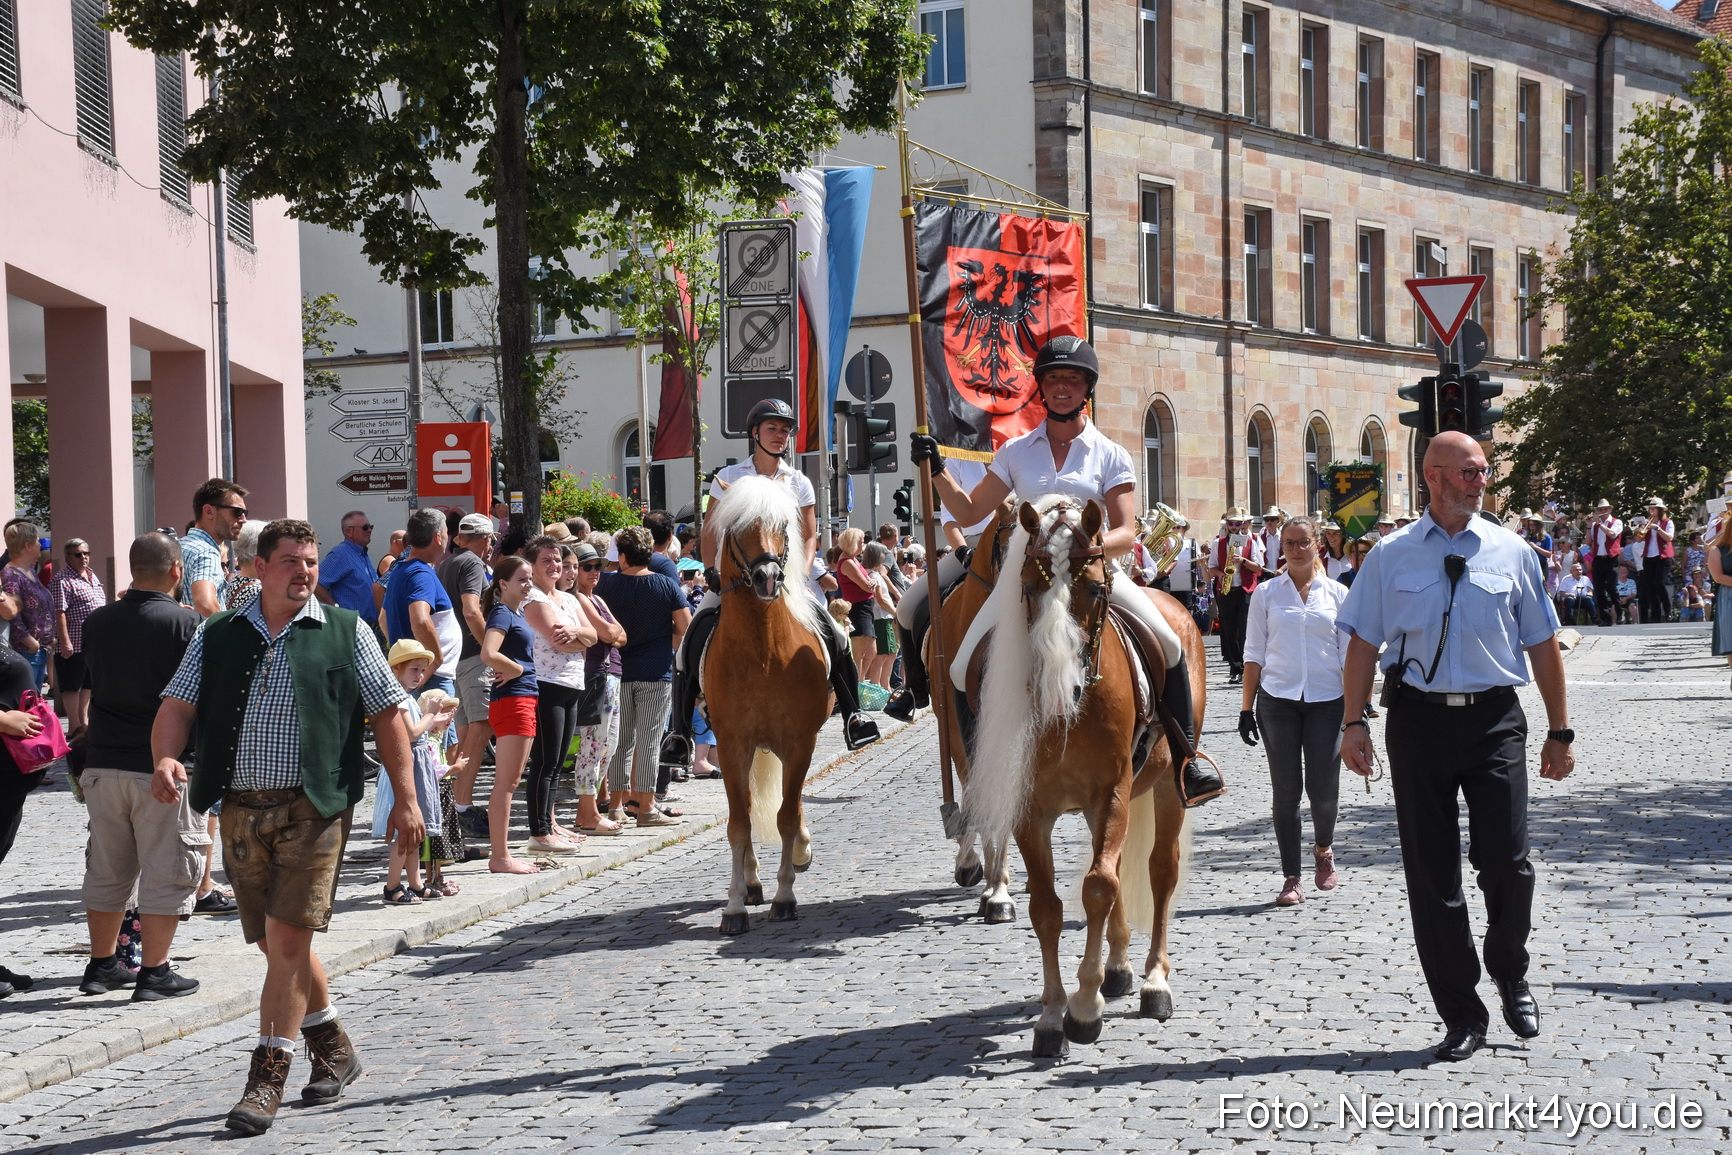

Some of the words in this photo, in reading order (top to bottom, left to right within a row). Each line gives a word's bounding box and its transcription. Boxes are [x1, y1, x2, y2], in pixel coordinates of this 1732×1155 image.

[743, 280, 775, 292] ZONE
[744, 356, 776, 369] ZONE
[345, 420, 376, 429] Berufliche
[371, 446, 403, 462] AOK
